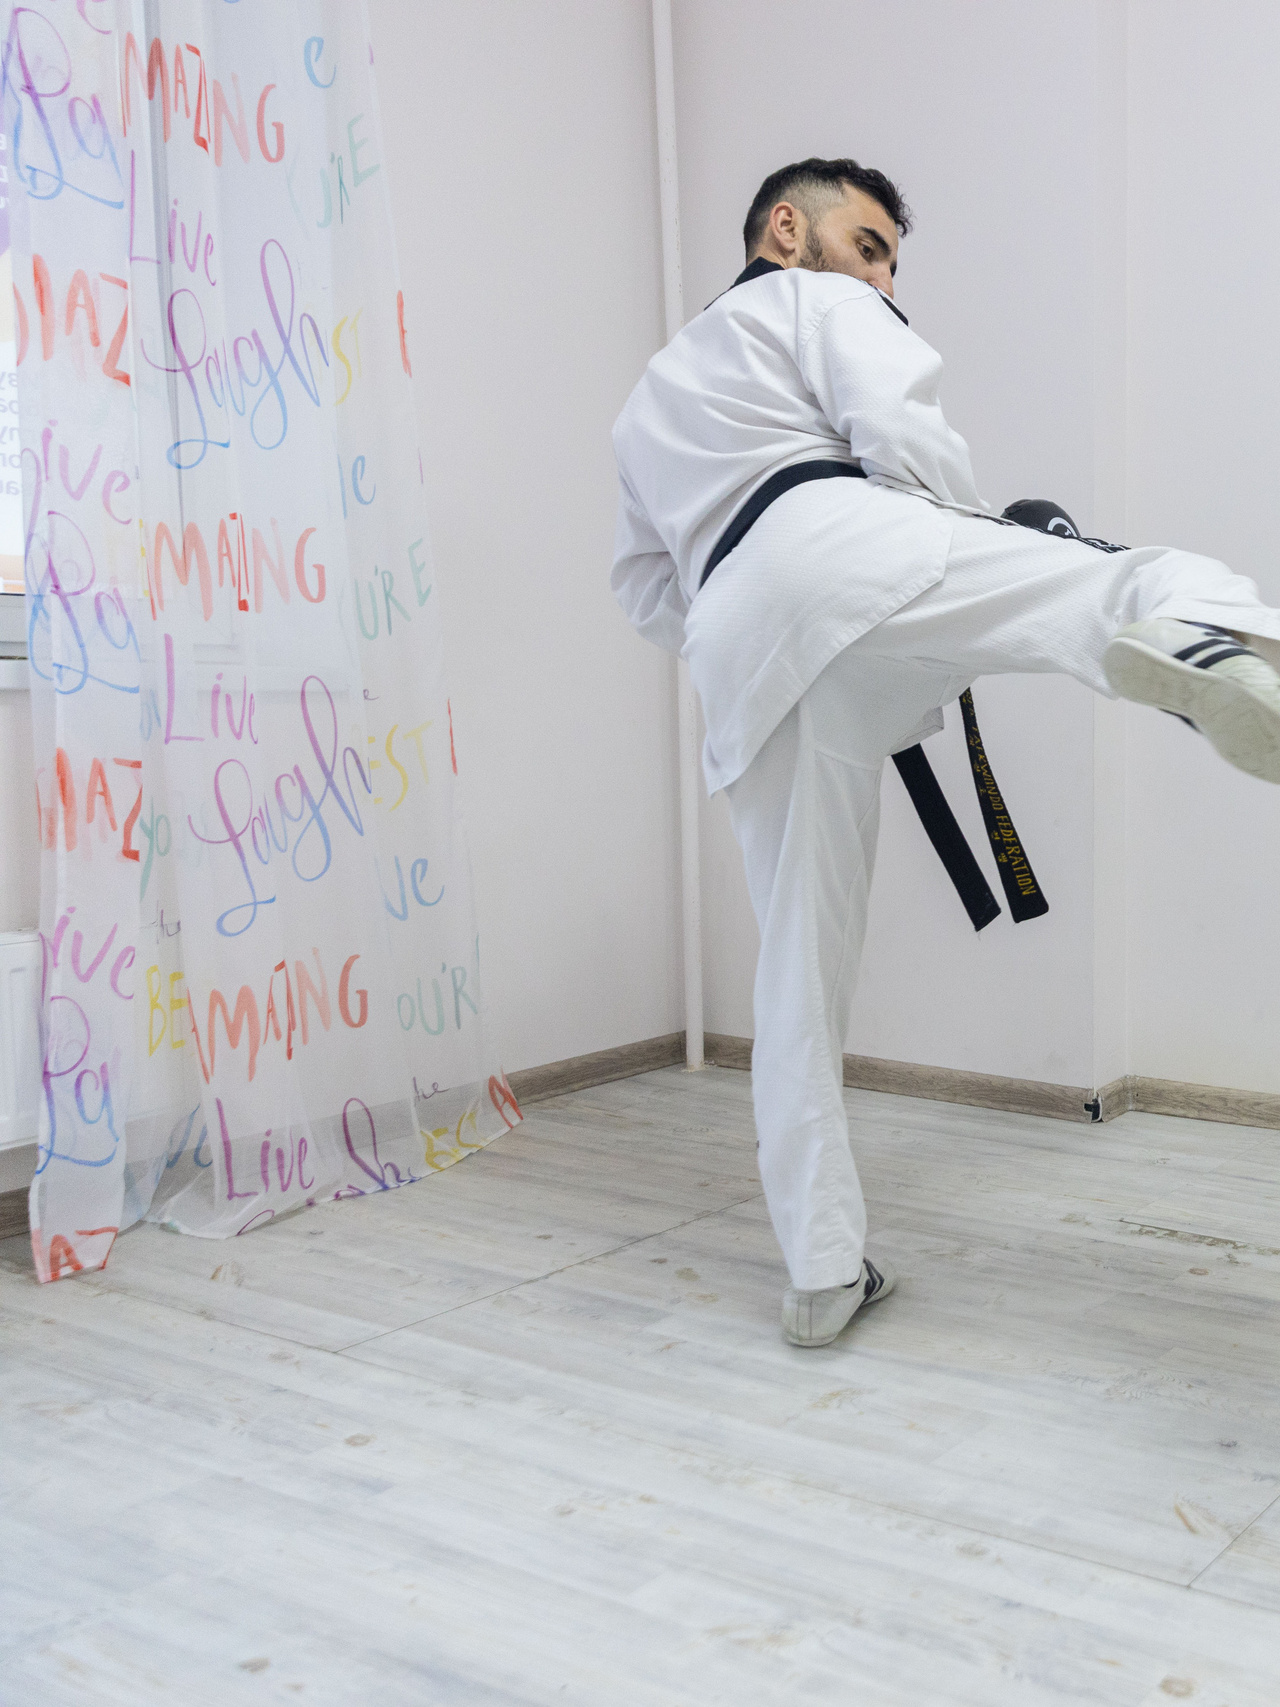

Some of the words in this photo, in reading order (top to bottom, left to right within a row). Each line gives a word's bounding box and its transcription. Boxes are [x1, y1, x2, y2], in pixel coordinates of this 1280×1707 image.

[129, 149, 217, 287] Live
[164, 633, 259, 745] Live
[996, 815, 1037, 896] FEDERATION
[215, 1097, 315, 1201] Live
